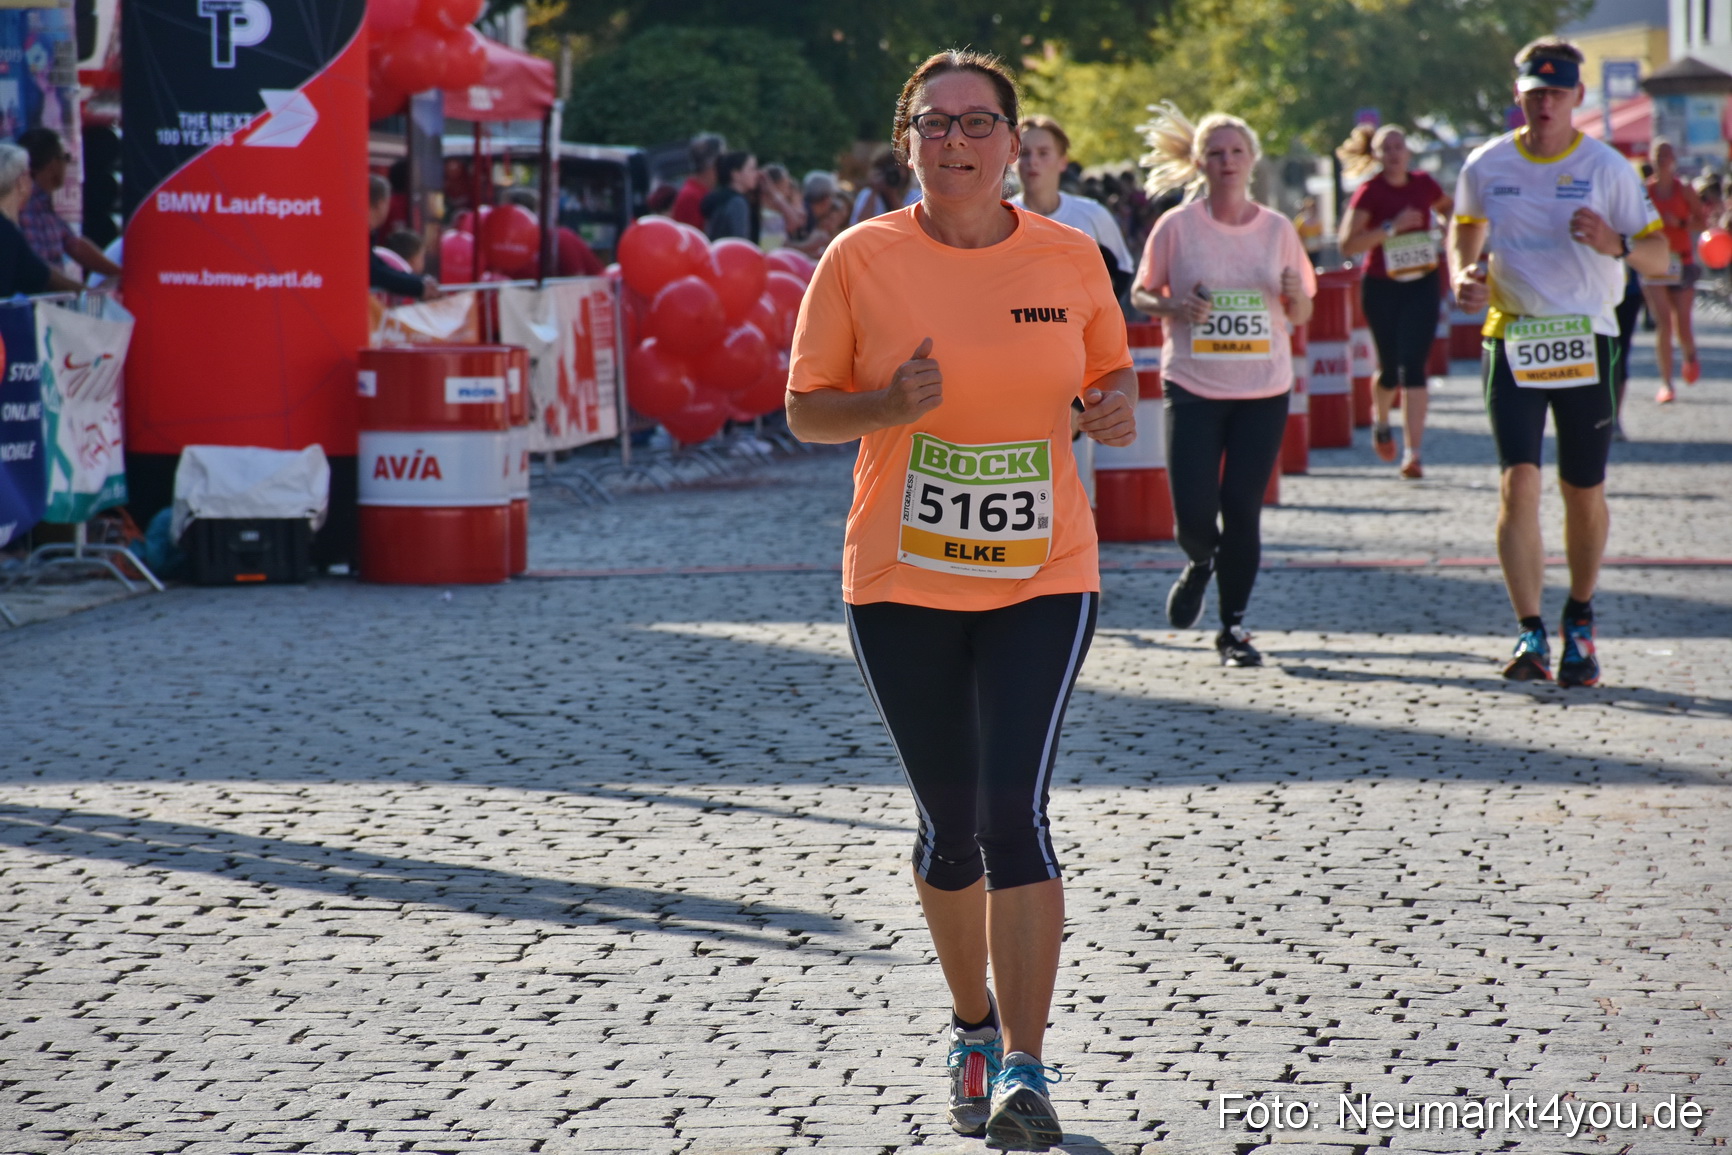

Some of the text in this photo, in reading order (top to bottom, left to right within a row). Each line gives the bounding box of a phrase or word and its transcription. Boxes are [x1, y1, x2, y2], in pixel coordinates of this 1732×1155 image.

[178, 112, 252, 130] THE NEXT
[156, 129, 234, 146] 100 YEARS
[157, 192, 322, 219] BMW Laufsport
[1212, 292, 1264, 309] OCK
[1010, 308, 1067, 323] THULE
[1201, 315, 1262, 336] 5065
[1511, 320, 1581, 338] BOCK
[1212, 342, 1252, 353] DARJA
[1517, 340, 1585, 366] 5088
[1526, 367, 1582, 380] MICHAEL
[374, 449, 442, 481] AVIA
[921, 441, 1038, 479] BOCK
[917, 483, 1035, 533] 5163
[944, 541, 1005, 562] ELKE
